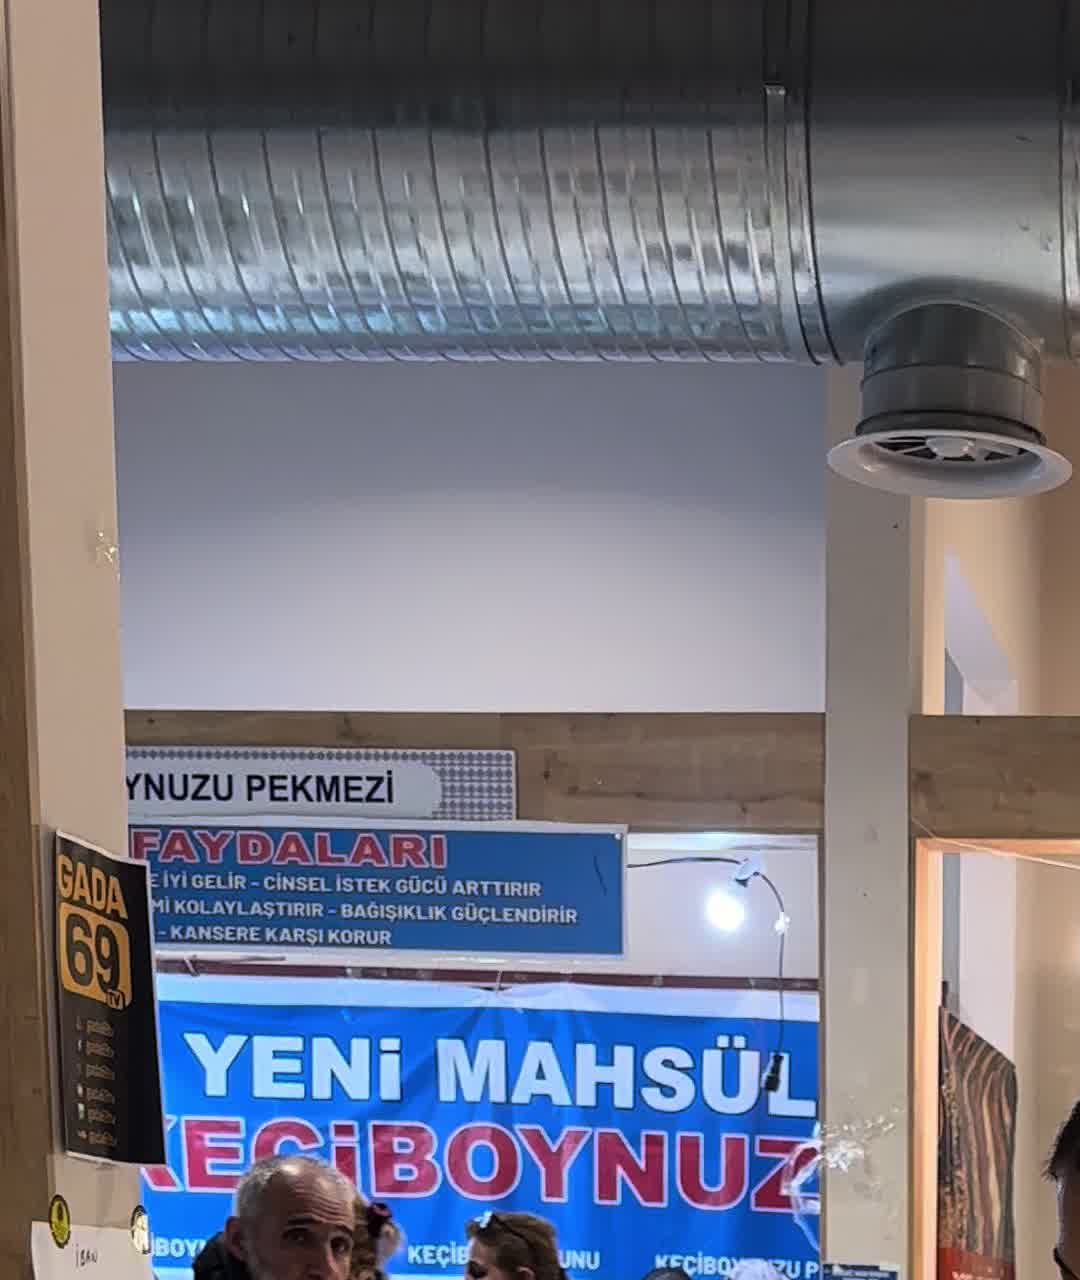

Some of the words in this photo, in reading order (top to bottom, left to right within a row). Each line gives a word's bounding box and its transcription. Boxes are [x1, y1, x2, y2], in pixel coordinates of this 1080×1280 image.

[247, 770, 394, 803] PEKMEZİ
[131, 829, 448, 869] FAYDALARI
[57, 853, 128, 920] GADA
[163, 869, 187, 888] İYİ
[191, 871, 246, 889] GELİR
[263, 872, 331, 892] CİNSEL
[335, 874, 390, 894] İSTEK
[396, 875, 447, 894] GÜCÜ
[452, 880, 542, 897] ARTTIRIR
[174, 899, 323, 918] KOLAYLAŞTIRIR
[341, 902, 447, 922] BAĞIŞIKLIK
[452, 902, 578, 924] GÜÇLENDİRİR
[64, 912, 120, 993] 69
[170, 925, 260, 942] KANSERE
[266, 927, 323, 945] KARŞI
[328, 930, 391, 945] KORUR
[437, 1034, 818, 1119] MAHSÜL
